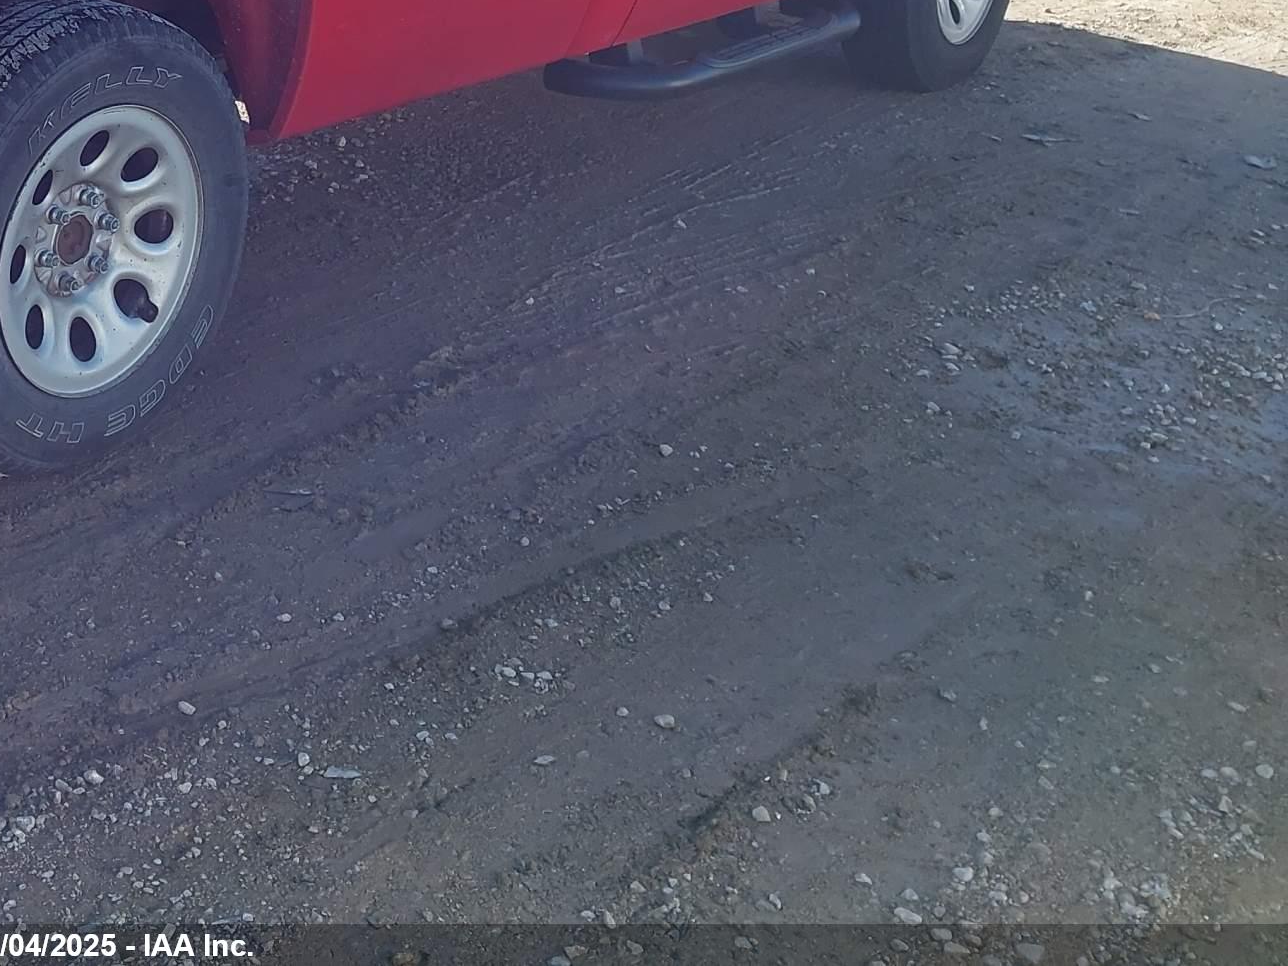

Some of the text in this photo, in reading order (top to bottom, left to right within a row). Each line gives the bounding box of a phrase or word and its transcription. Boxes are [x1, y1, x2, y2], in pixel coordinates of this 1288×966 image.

[27, 66, 184, 155] KELLY
[15, 305, 214, 444] EDGE HT
